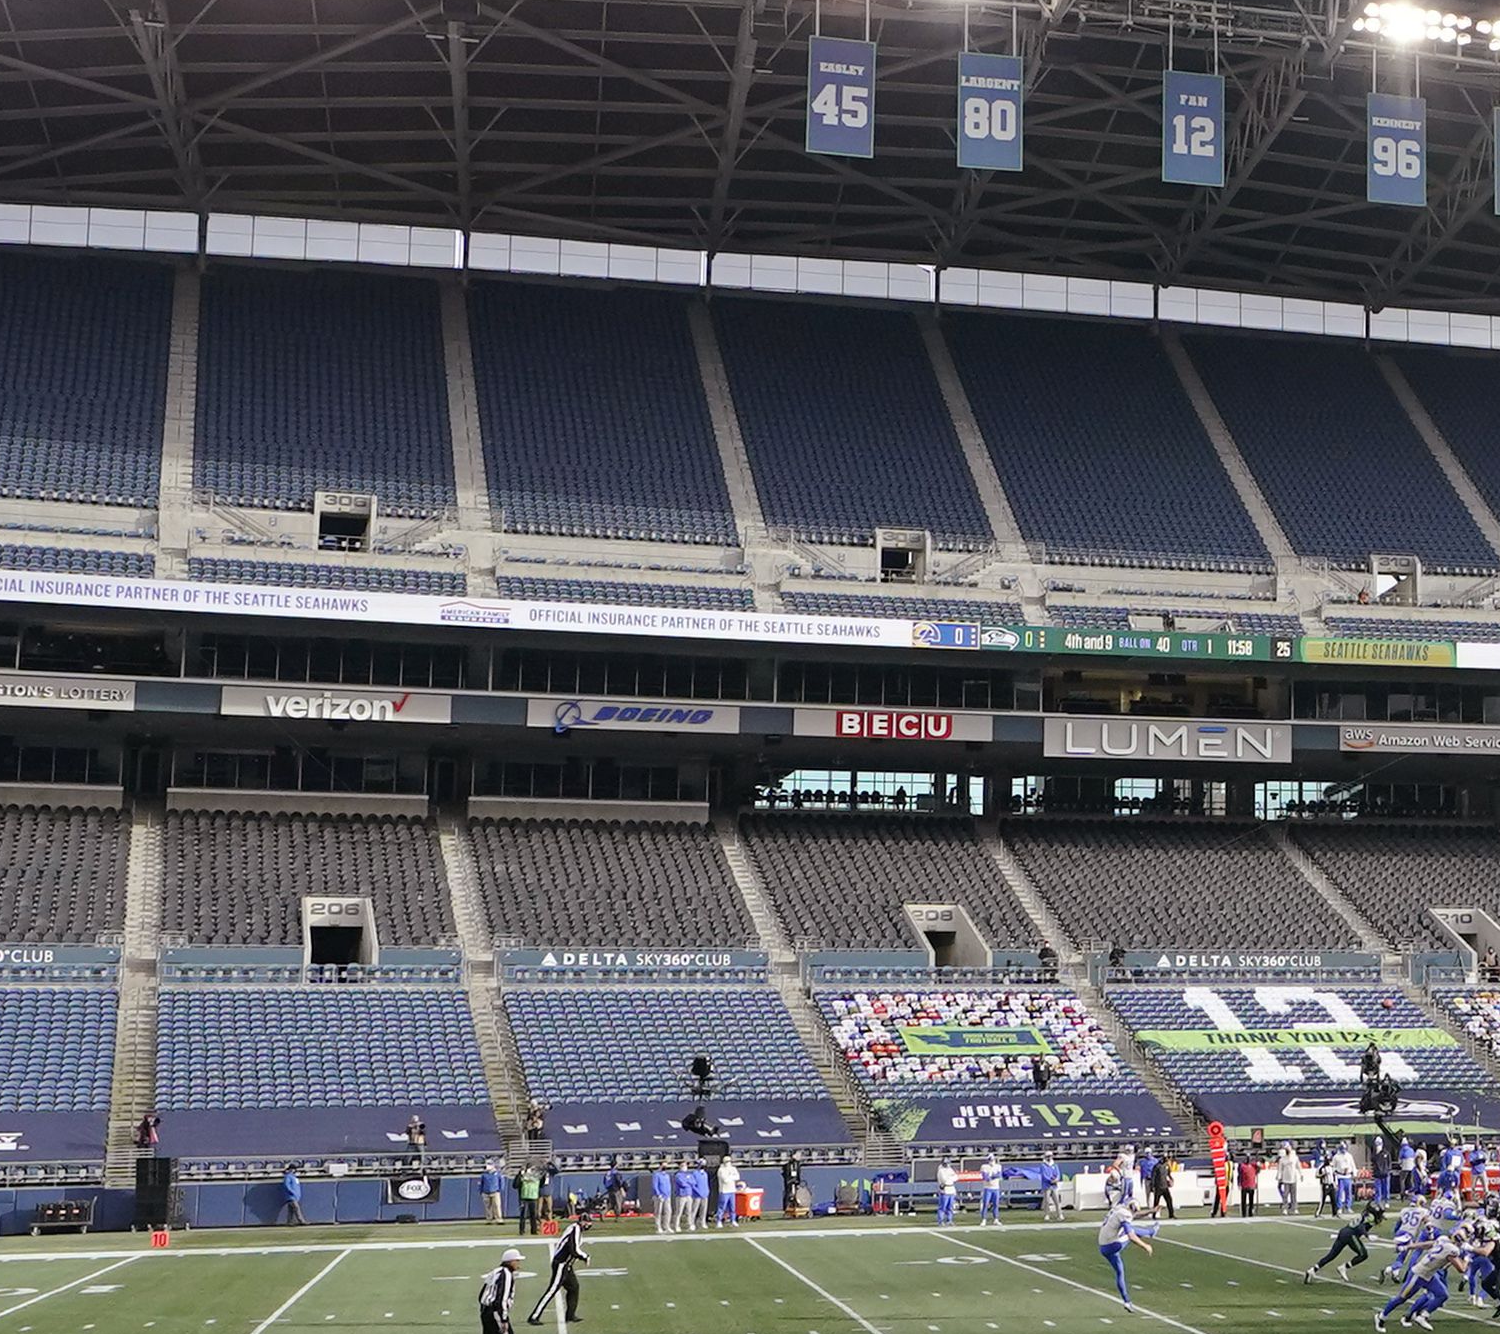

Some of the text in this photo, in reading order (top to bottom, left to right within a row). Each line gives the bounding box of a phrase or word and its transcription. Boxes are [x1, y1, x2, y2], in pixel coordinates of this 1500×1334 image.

[811, 84, 869, 127] 45
[1179, 93, 1208, 107] FAN
[964, 97, 1016, 140] 80
[1371, 116, 1422, 131] KENNEDY
[1172, 114, 1216, 157] 12
[1372, 137, 1421, 179] 96
[955, 628, 964, 645] 0
[1025, 631, 1033, 648] 0
[1065, 633, 1083, 650] 4th
[1083, 633, 1105, 650] and
[1105, 633, 1113, 649] 9
[1119, 635, 1138, 648] BALL
[1139, 636, 1151, 649] ON
[1156, 635, 1170, 652] 40
[1207, 638, 1213, 654] 1
[1226, 638, 1253, 655] 11:58
[1277, 640, 1291, 657] 25
[1323, 641, 1429, 662] SEATTLE SEAHAWKS
[60, 687, 132, 702] LOTTERY
[266, 691, 396, 721] verizon
[591, 706, 714, 725] BOEING
[841, 713, 950, 738] BECU
[1345, 727, 1374, 742] aws
[1065, 722, 1274, 759] LUMEN
[1378, 732, 1430, 748] Amazon
[1432, 734, 1460, 748] Web
[309, 902, 360, 917] 206
[951, 1103, 1121, 1128] OF THE 12s
[959, 1104, 1026, 1117] HOME
[1401, 1209, 1420, 1226] 35
[542, 1221, 556, 1235] 20
[151, 1231, 168, 1247] 10
